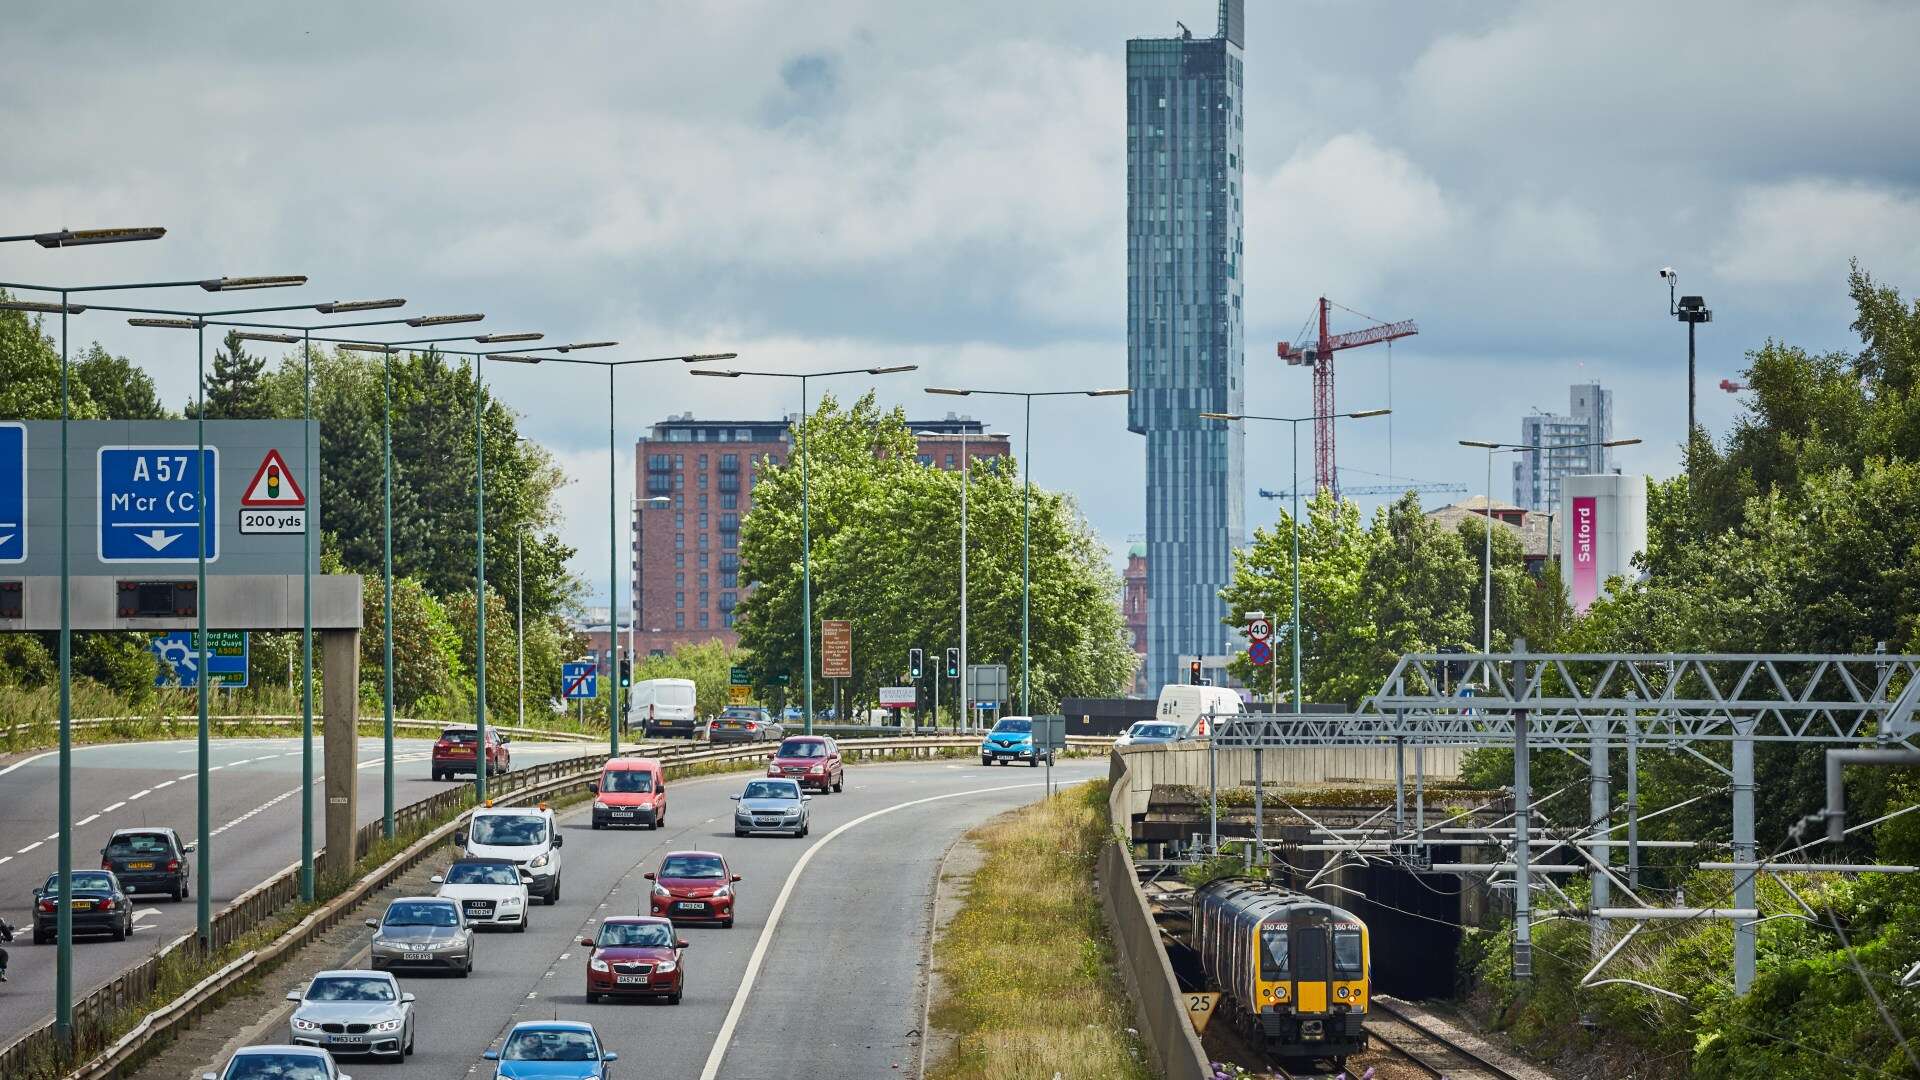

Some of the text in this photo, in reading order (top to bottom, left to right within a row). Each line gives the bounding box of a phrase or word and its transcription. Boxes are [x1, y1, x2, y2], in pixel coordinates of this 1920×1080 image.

[245, 515, 301, 529] 200 yds
[1578, 507, 1591, 562] Salford
[1252, 624, 1268, 635] 40
[1275, 923, 1288, 931] 402
[1347, 923, 1360, 931] 402
[1190, 995, 1210, 1012] 25
